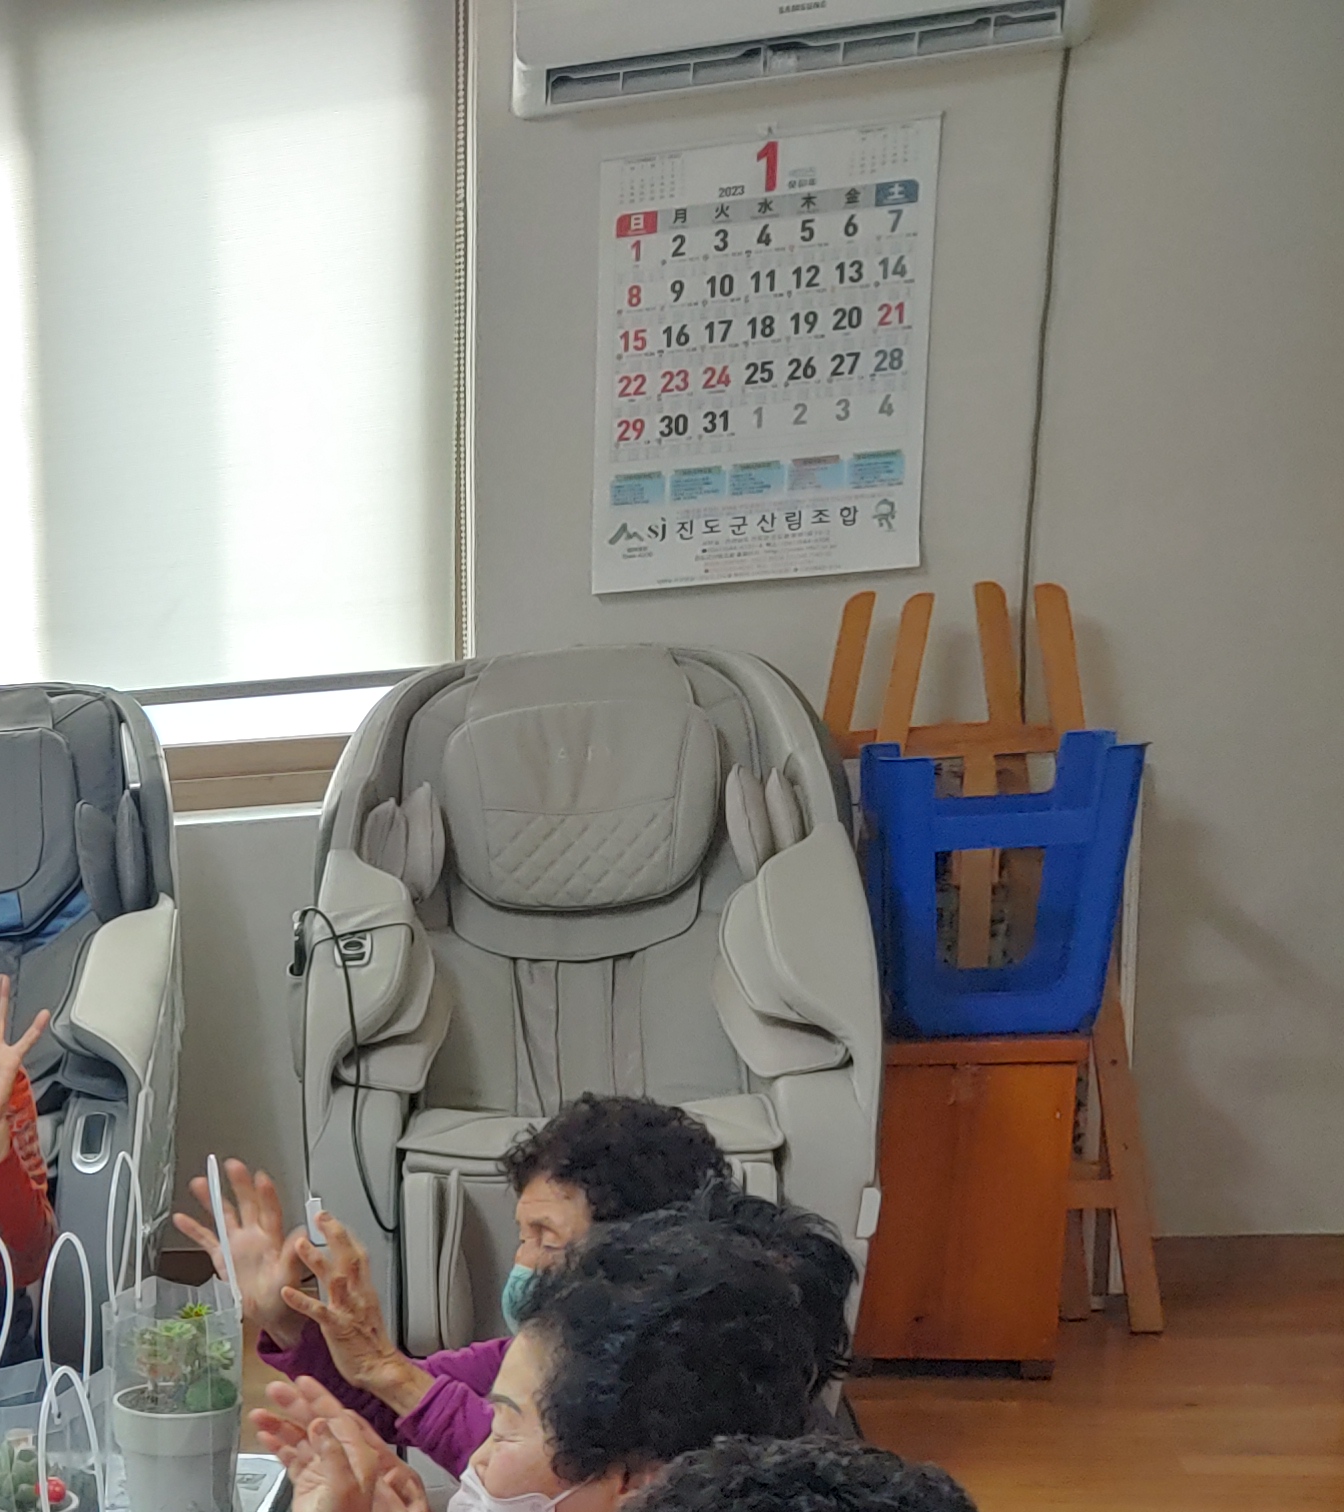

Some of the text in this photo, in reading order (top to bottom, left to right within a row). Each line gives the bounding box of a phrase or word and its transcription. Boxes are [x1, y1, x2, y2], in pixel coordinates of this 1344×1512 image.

[718, 185, 746, 198] 2023
[756, 141, 779, 192] 1
[630, 184, 905, 229] 日 月 火 水 木 金 土
[631, 210, 903, 262] 1 2 3 4 5 6 7
[628, 255, 907, 307] 8 9 10 11 12 13 14
[619, 302, 905, 352] 15 16 17 18 19 20 21
[617, 348, 904, 398] 22 23 24 25 26 27 28
[617, 394, 894, 442] 29 30 31 1 2 3 4
